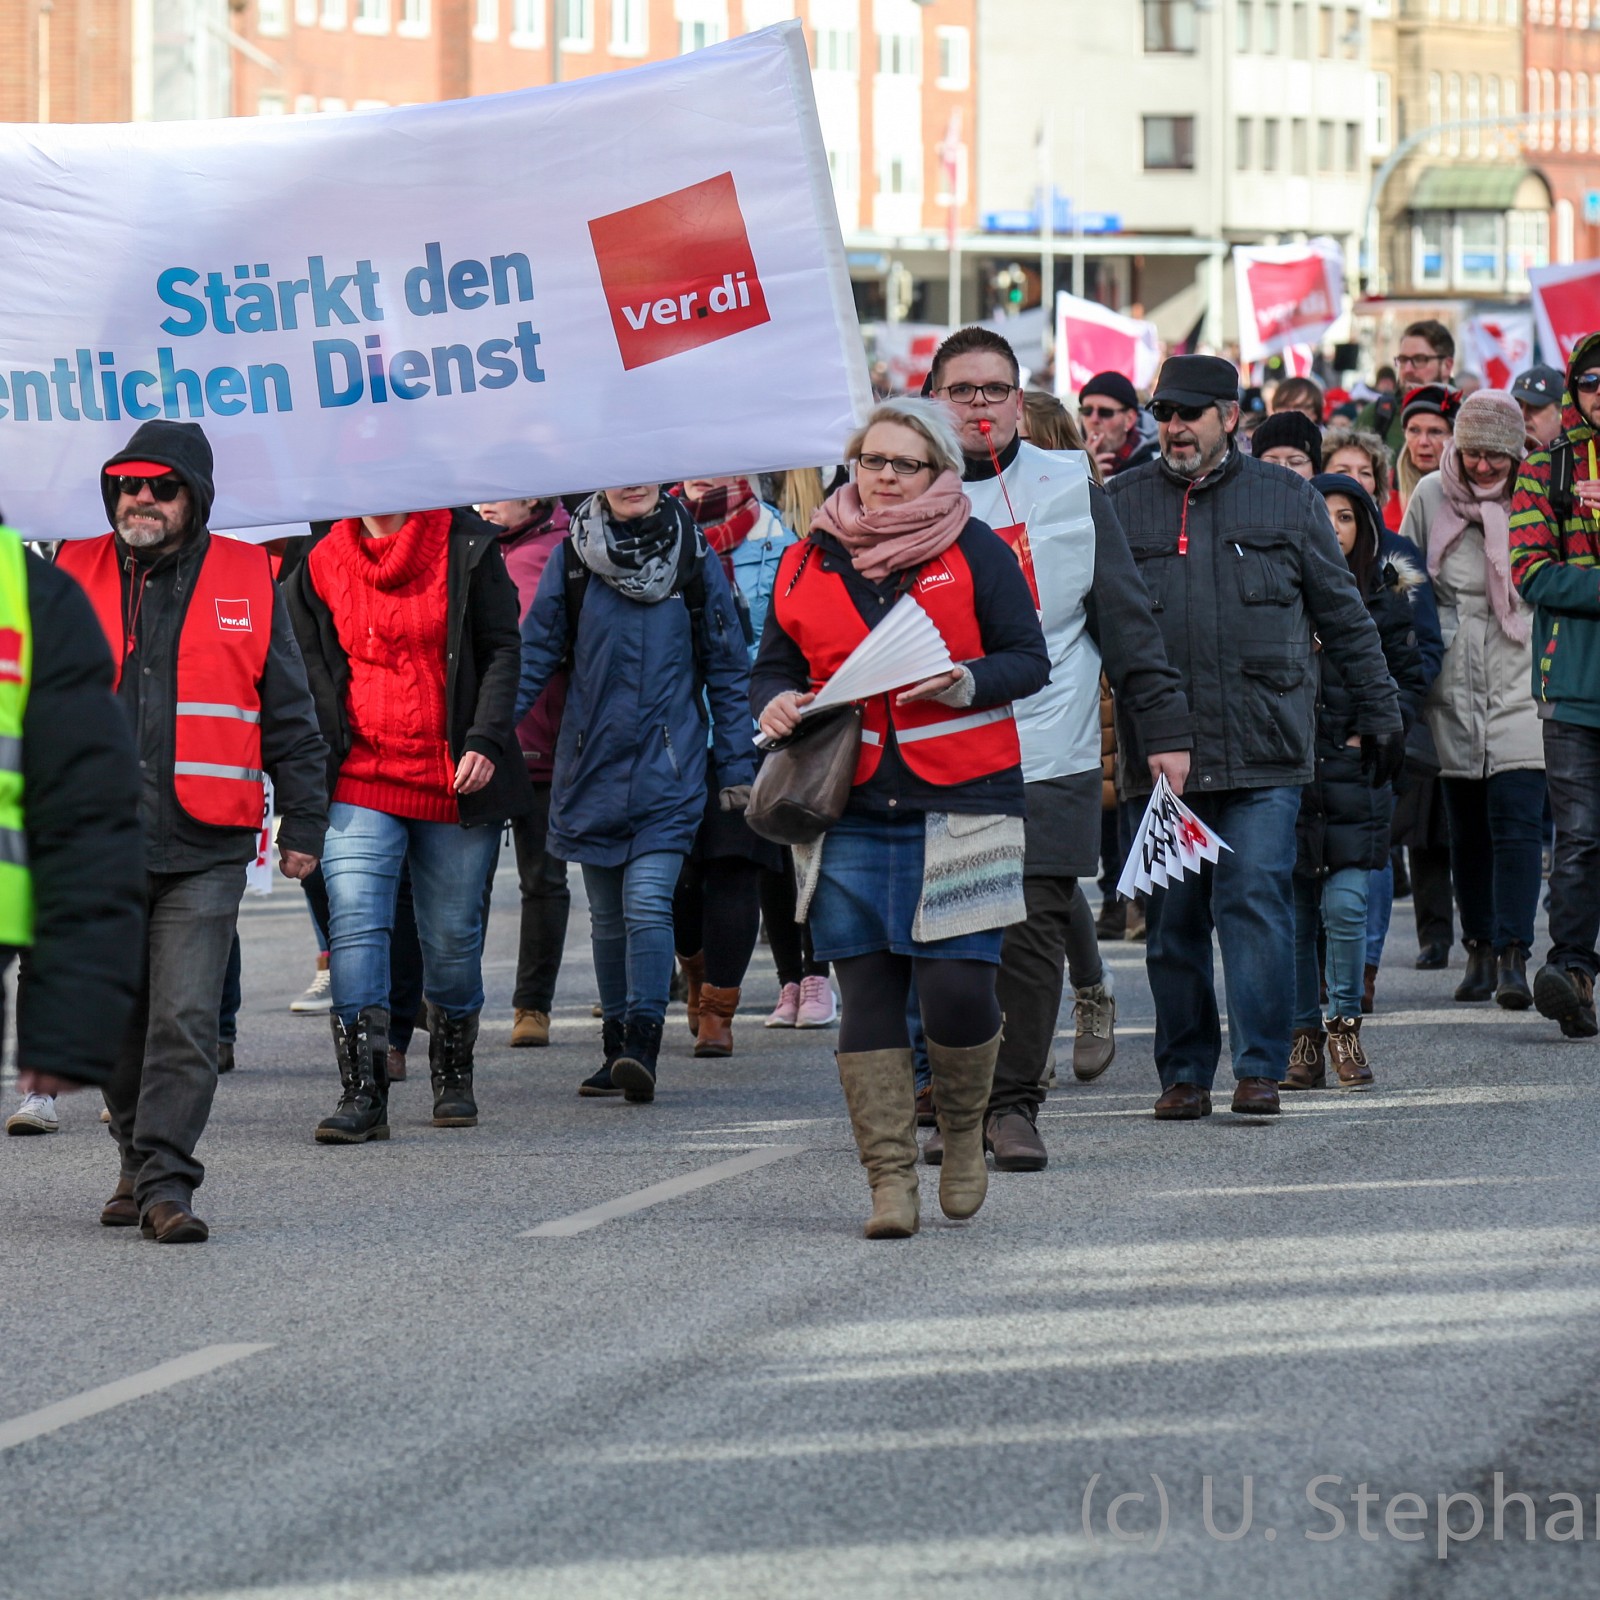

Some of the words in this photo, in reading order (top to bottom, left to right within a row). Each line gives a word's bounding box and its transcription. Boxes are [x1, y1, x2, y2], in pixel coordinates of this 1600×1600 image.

[156, 255, 384, 337] Stärkt
[404, 242, 535, 316] den
[621, 271, 751, 331] ver.di
[0, 343, 294, 422] ntlichen
[313, 321, 546, 409] Dienst
[921, 571, 950, 585] ver.di
[220, 616, 249, 627] ver.di
